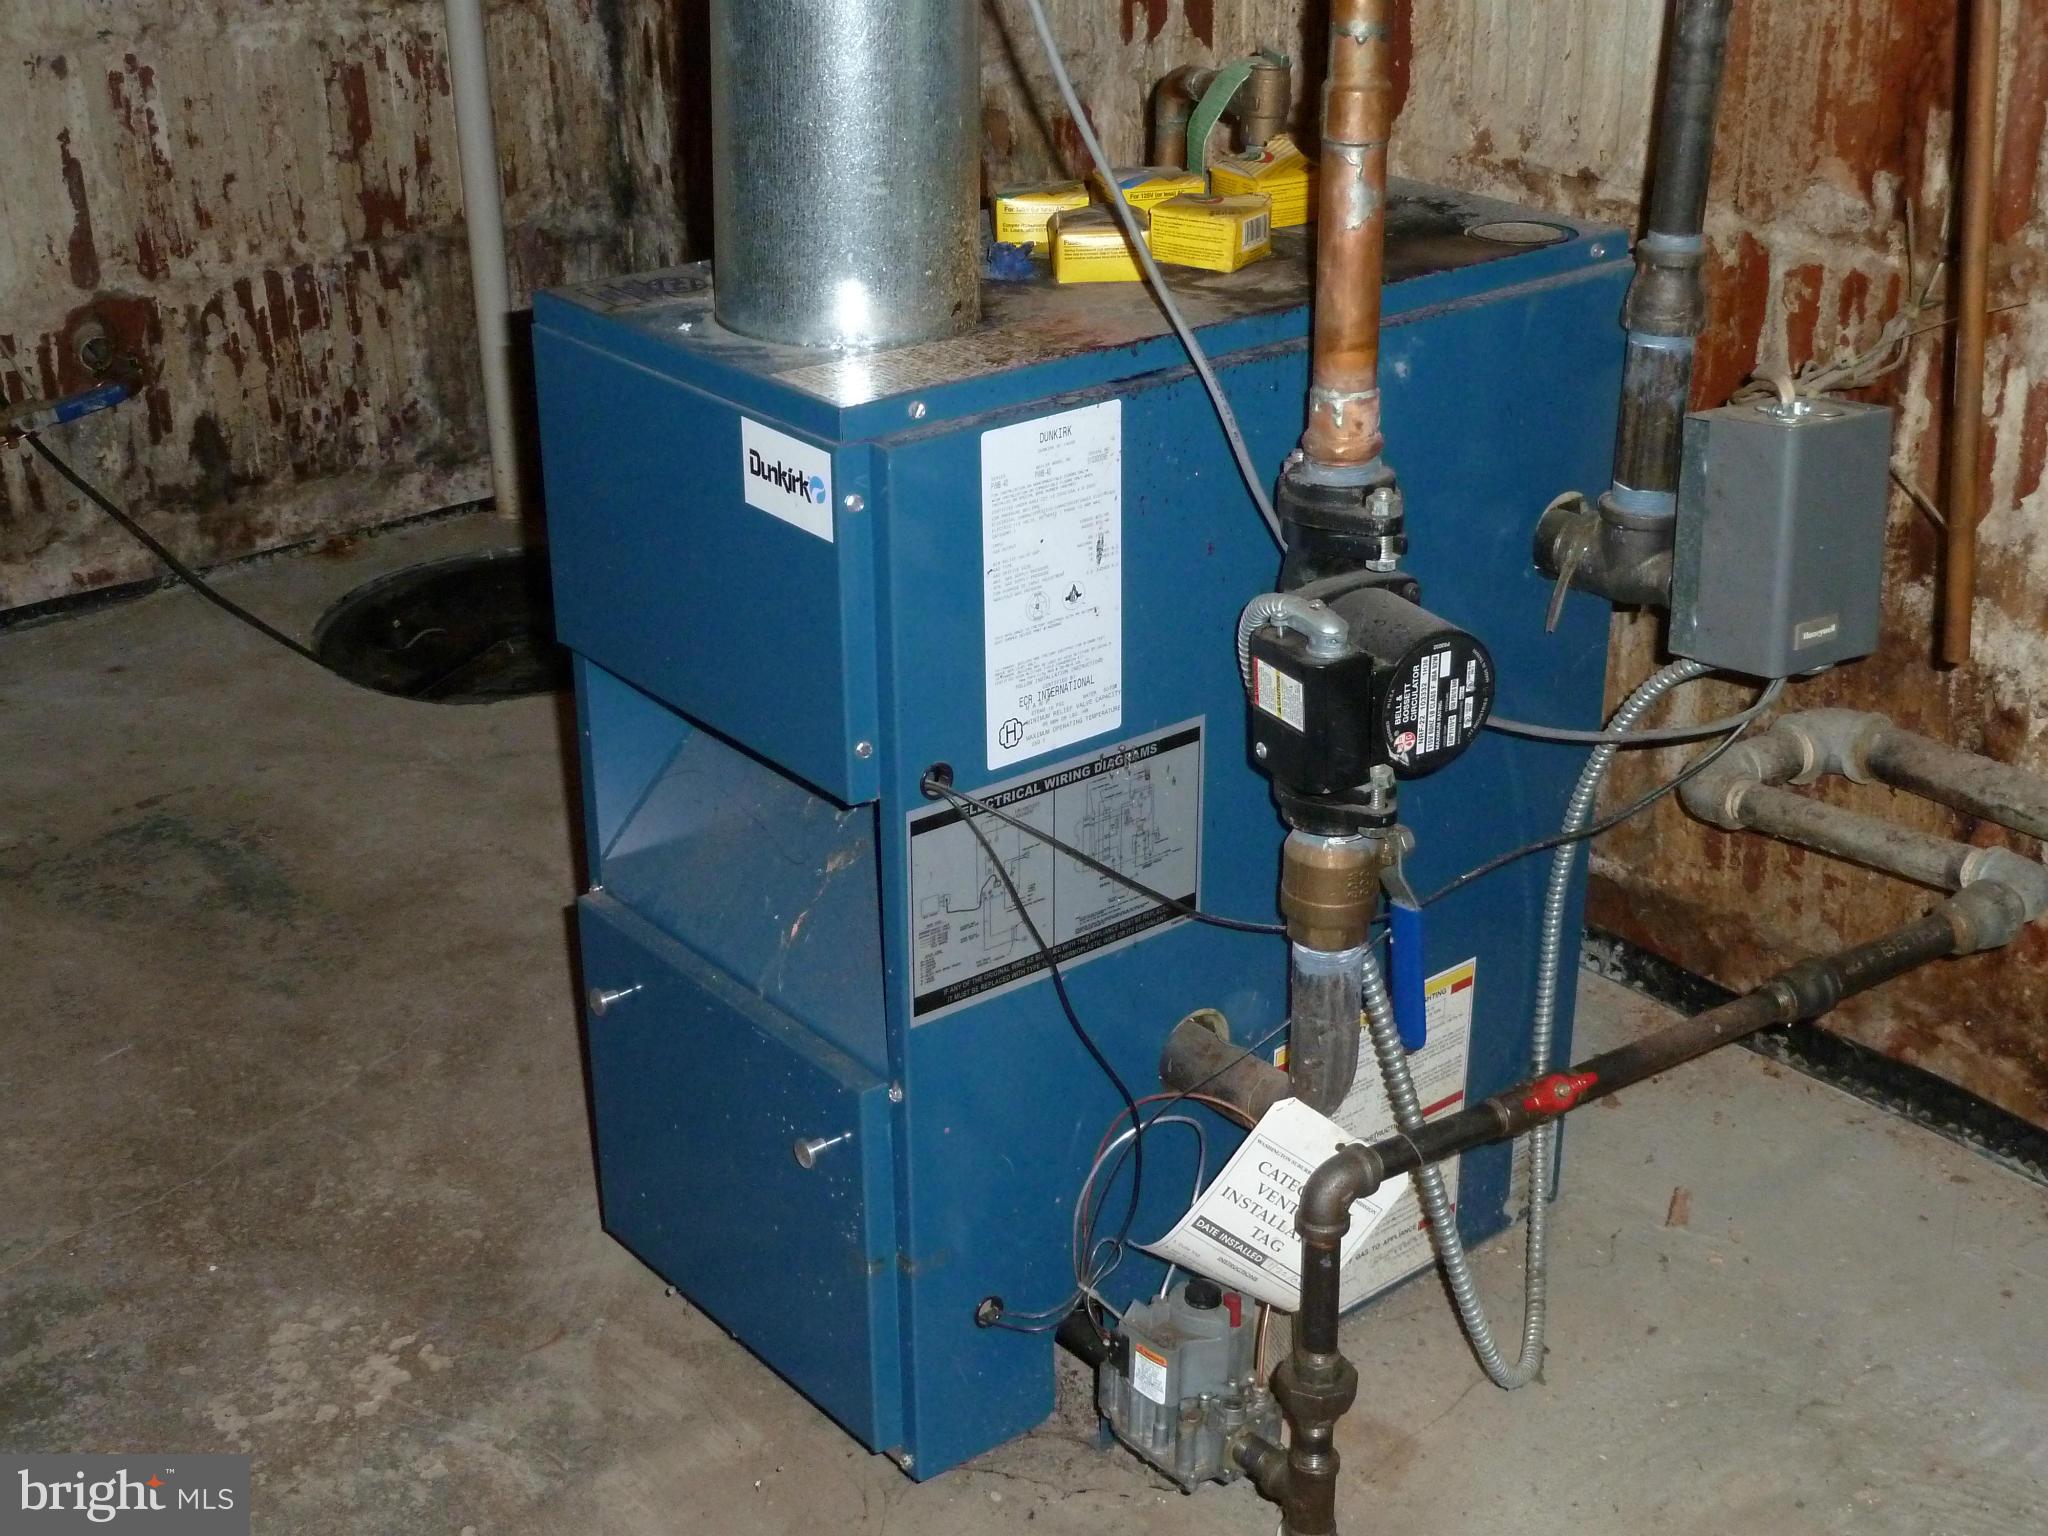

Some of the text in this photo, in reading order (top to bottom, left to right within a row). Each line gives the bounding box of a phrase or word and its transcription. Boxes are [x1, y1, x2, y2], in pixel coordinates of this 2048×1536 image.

[1039, 425, 1071, 443] DUNKIRK
[749, 448, 811, 503] Dunkirk
[1018, 673, 1094, 708] ECR INTERNATIONAL
[1411, 665, 1419, 720] CIRCULATOR
[1006, 721, 1016, 743] H
[1052, 718, 1082, 732] OPERATING
[1085, 705, 1120, 721] TEMPERATURE
[1044, 767, 1091, 790] WIRING
[1094, 744, 1157, 773] DIAGRAMS
[1255, 1138, 1292, 1162] WASHINGTON
[1194, 1218, 1220, 1237] DATE
[1217, 1232, 1264, 1264] INSTALLED
[1247, 1225, 1285, 1253] TAG
